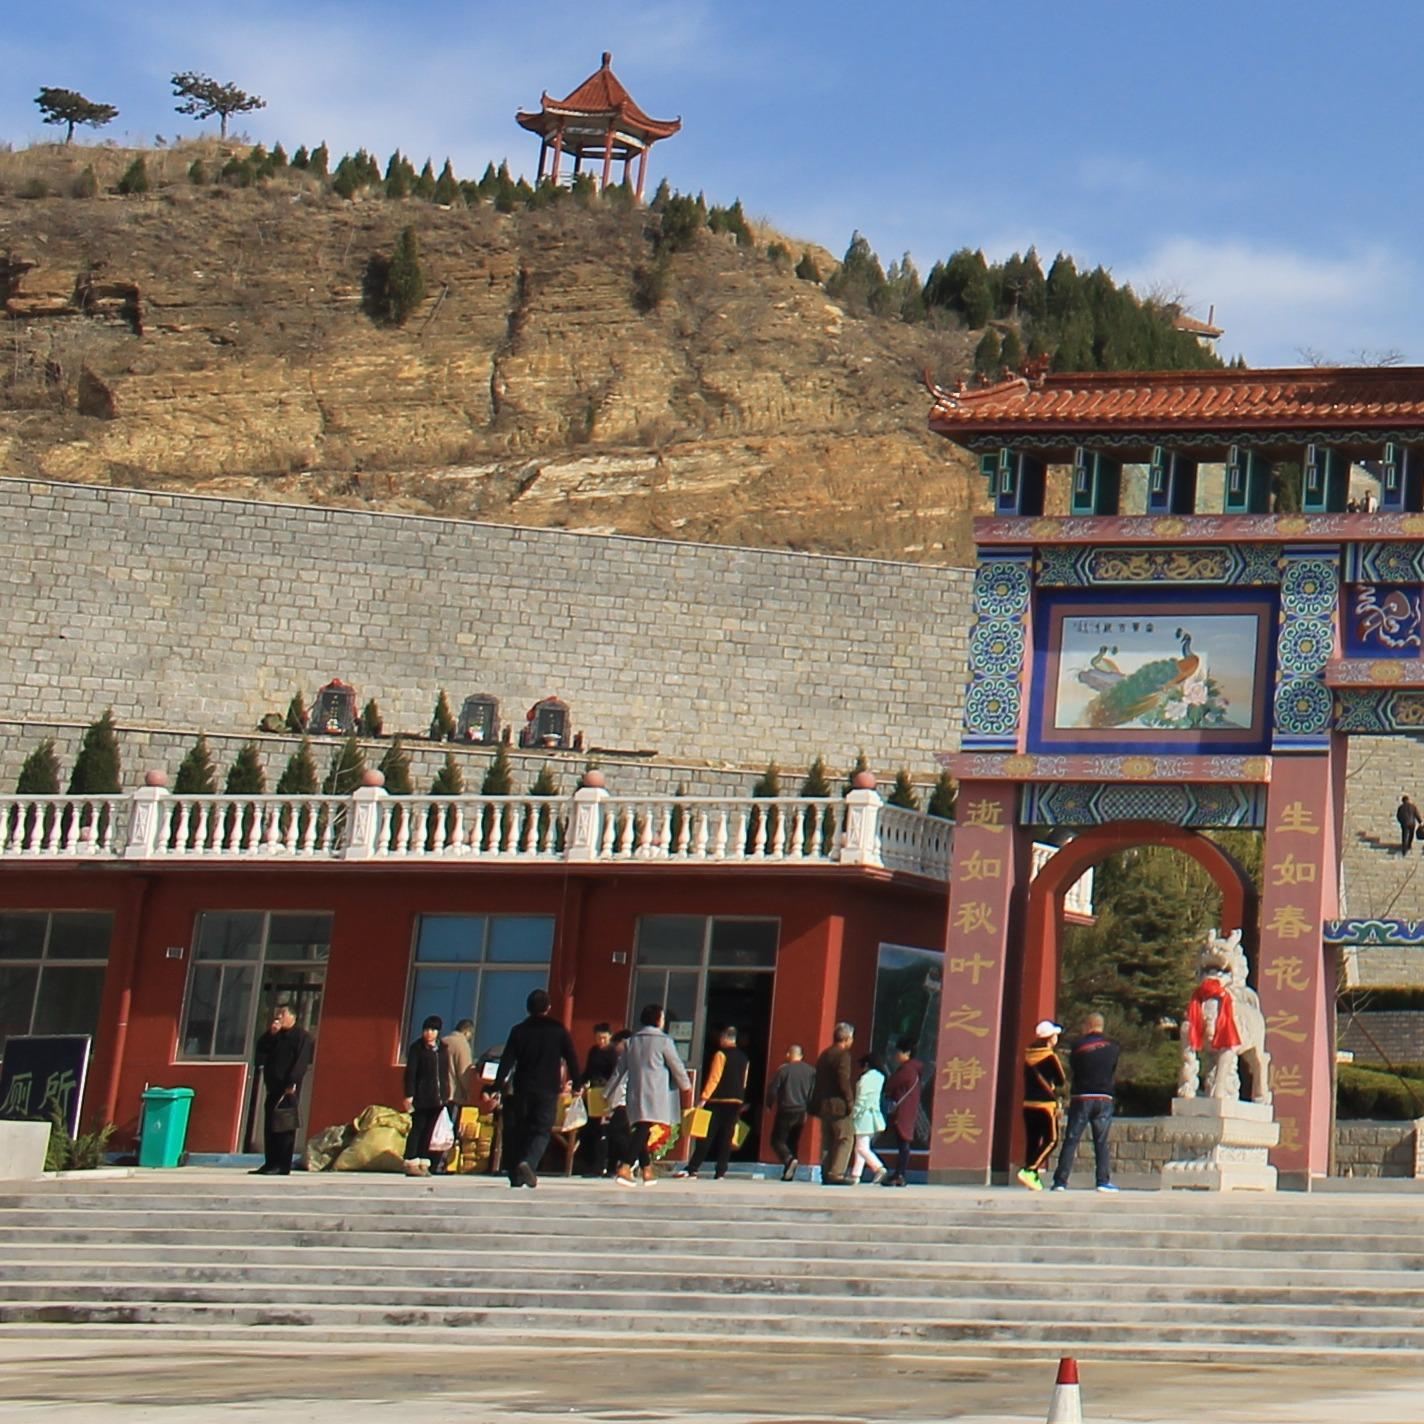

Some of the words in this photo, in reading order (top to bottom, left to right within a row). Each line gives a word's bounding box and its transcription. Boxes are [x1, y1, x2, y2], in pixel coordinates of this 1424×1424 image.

[936, 798, 1005, 1145] 逝如秋叶之静美
[0, 1068, 77, 1117] 厕所
